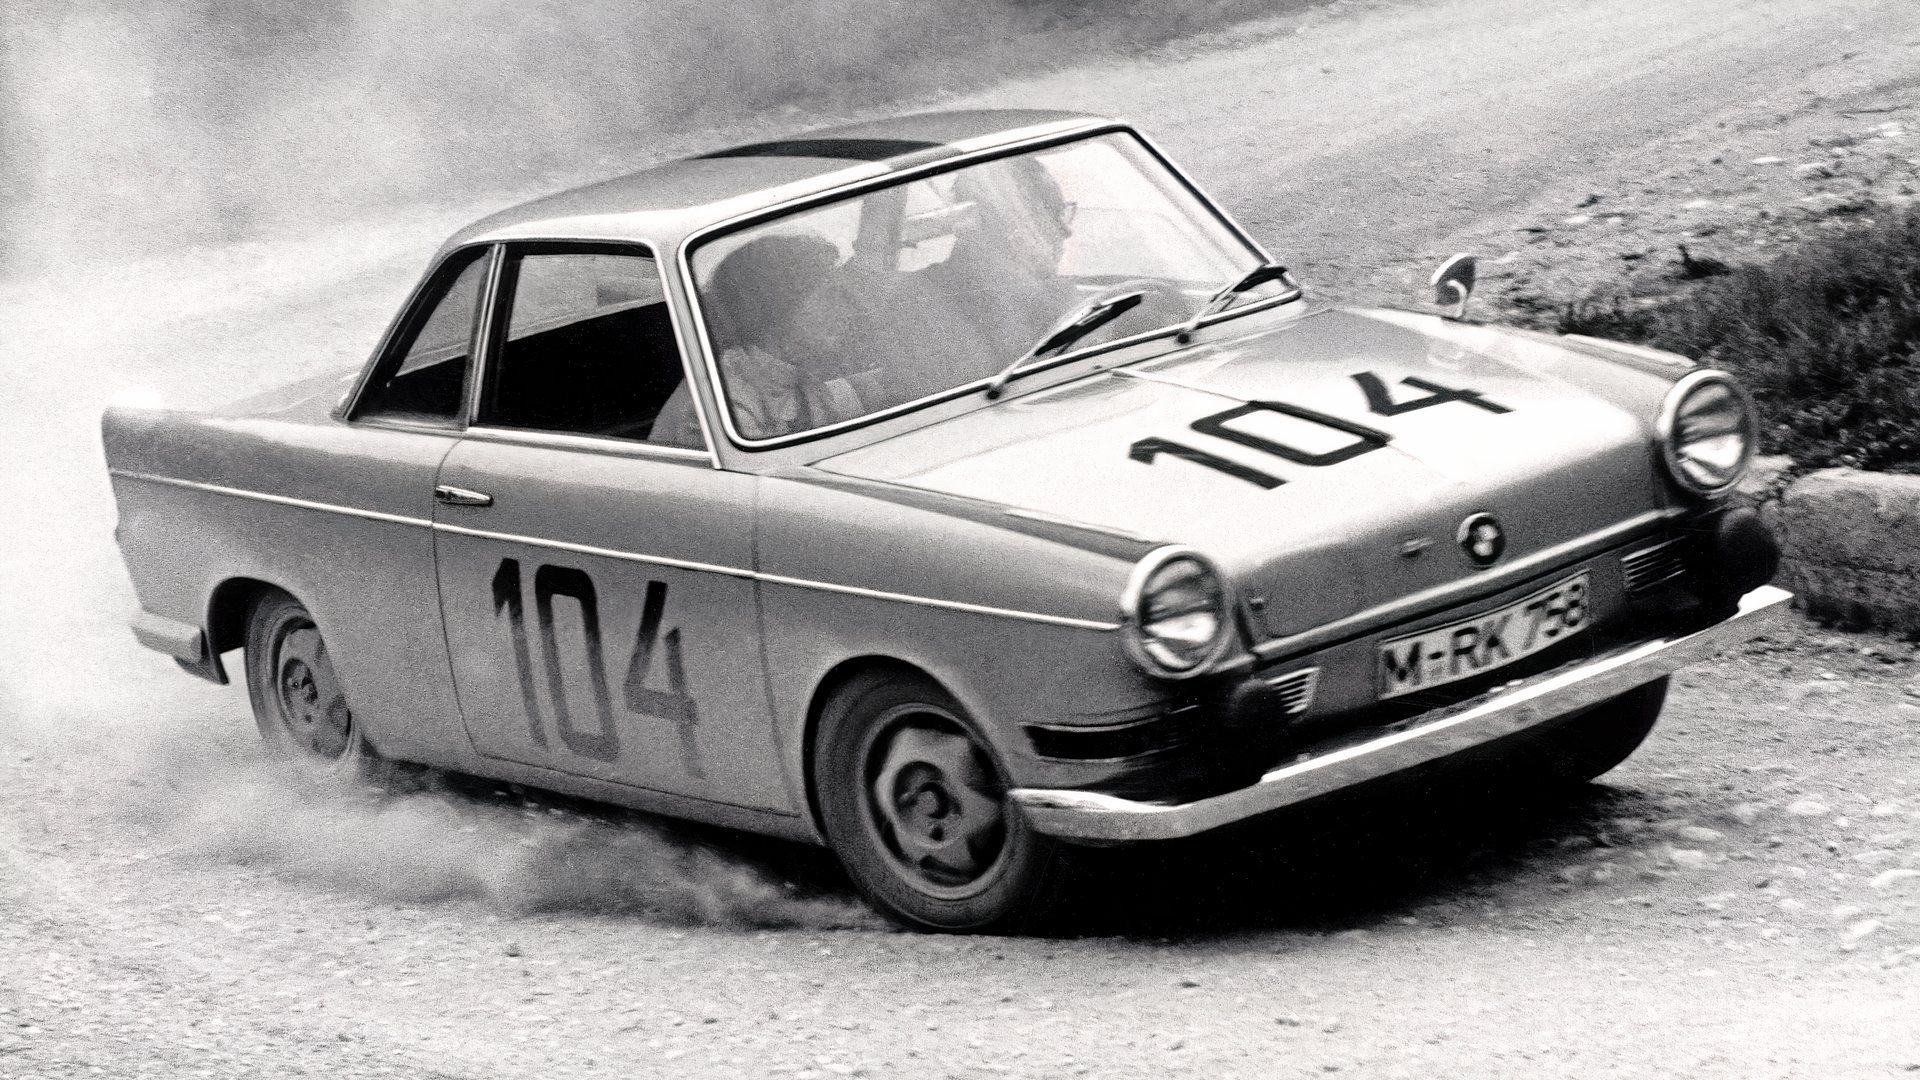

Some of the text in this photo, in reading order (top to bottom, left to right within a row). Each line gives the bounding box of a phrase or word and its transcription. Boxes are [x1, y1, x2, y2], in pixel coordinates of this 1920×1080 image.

[1128, 371, 1516, 491] 104
[492, 557, 706, 780] 104
[1379, 613, 1509, 694] M-RK
